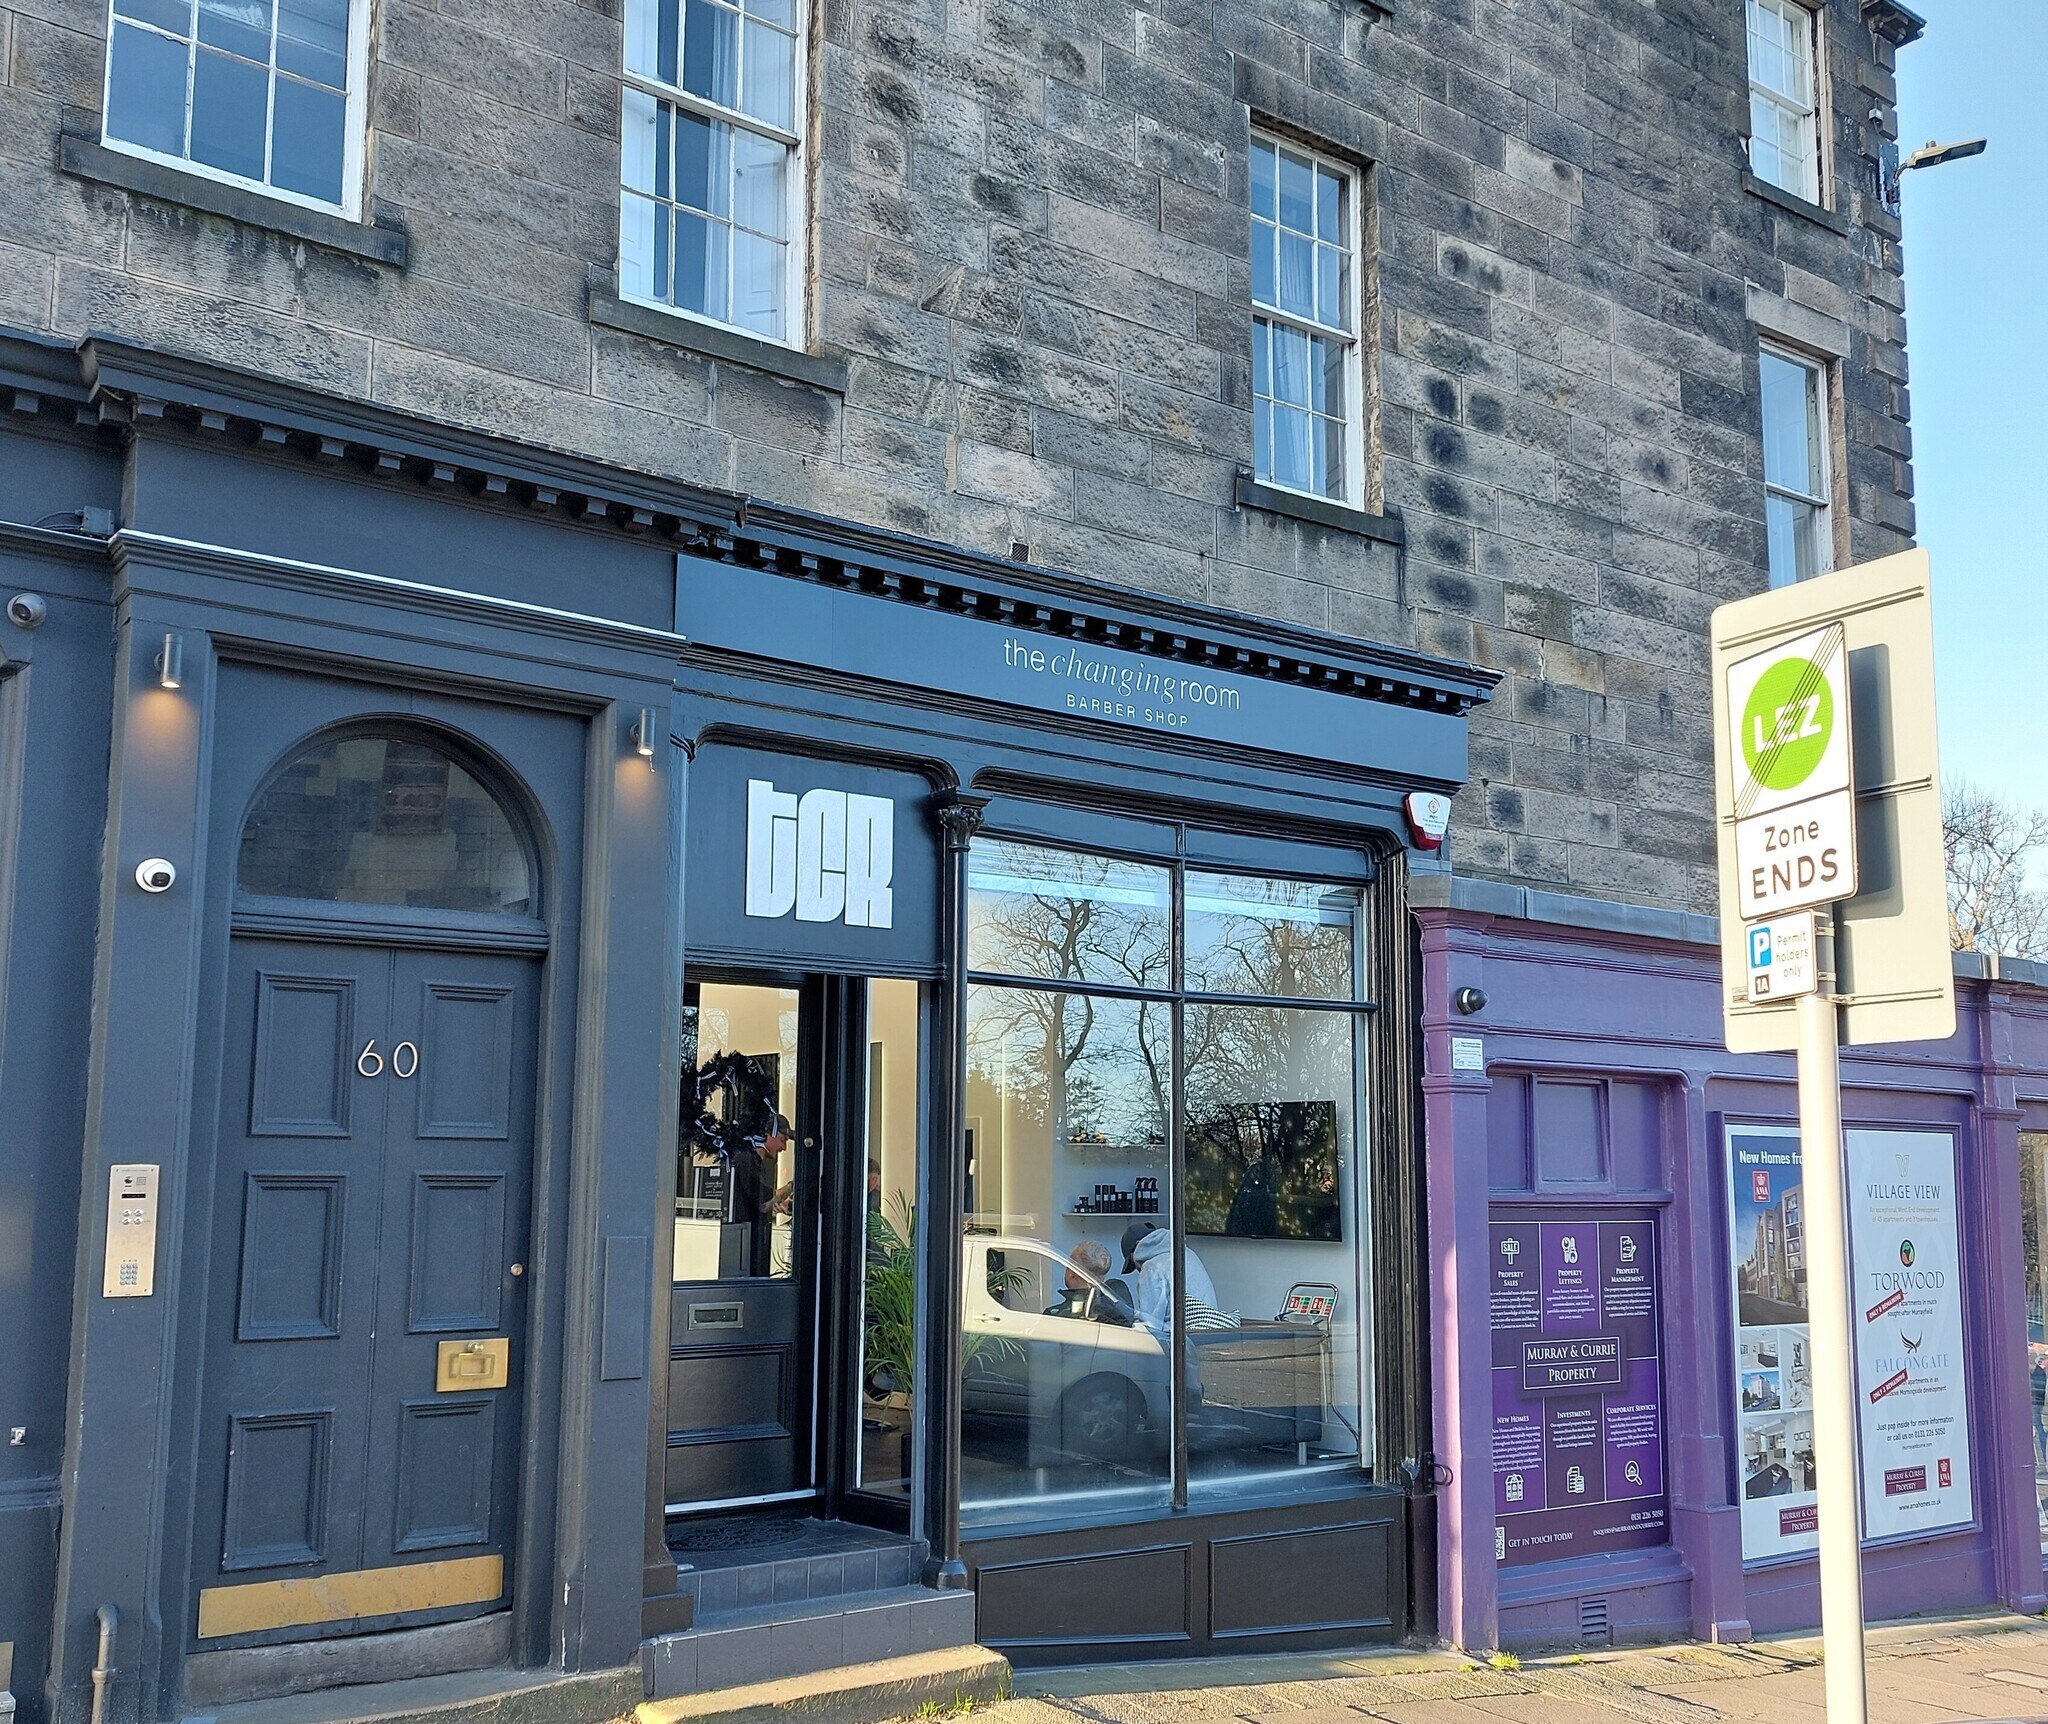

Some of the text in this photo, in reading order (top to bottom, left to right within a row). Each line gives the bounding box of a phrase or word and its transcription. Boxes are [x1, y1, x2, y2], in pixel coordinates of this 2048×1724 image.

[1003, 638, 1241, 710] the changing room
[1066, 693, 1189, 727] BARBER SHOP
[1753, 693, 1823, 754] LEZ
[1764, 820, 1820, 853] Zone
[1751, 847, 1839, 900] ENDS
[1776, 930, 1807, 947] Permit
[1775, 948, 1809, 963] holders
[1783, 964, 1803, 978] only
[1755, 976, 1770, 993] 1A
[357, 1039, 419, 1078] 60
[1739, 1150, 1804, 1165] New Homes fro
[1866, 1184, 1940, 1199] VILLAGE VIEW
[1497, 1271, 1524, 1279] PROPERTY
[1557, 1269, 1583, 1277] PROPERTY
[1871, 1271, 1945, 1292] TORWOOD
[1911, 1308, 1933, 1317] Murrayfield
[1527, 1344, 1617, 1361] MURRAY & CURRIE
[1875, 1354, 1950, 1373] FALCONGATE
[1548, 1367, 1598, 1382] PROPERTY
[1556, 1409, 1591, 1419] INVESTMENTS
[1606, 1404, 1657, 1414] CORPORATE SERVICES
[1496, 1415, 1530, 1424] NEW HOMES
[1876, 1423, 1887, 1431] Just
[1887, 1423, 1897, 1432] pop
[1896, 1420, 1910, 1429] inside
[1910, 1419, 1918, 1427] for
[1929, 1416, 1955, 1425] information
[1892, 1433, 1902, 1441] call
[1914, 1430, 1926, 1439] 0131
[1926, 1428, 1935, 1437] 226
[1886, 1472, 1905, 1482] MURRAY
[1908, 1470, 1925, 1479] CURRIE
[1895, 1482, 1917, 1492] PROPERTY
[1630, 1512, 1642, 1521] 0131
[1642, 1511, 1652, 1520] 226
[1508, 1531, 1575, 1548] GET IN TOUCH TODAY
